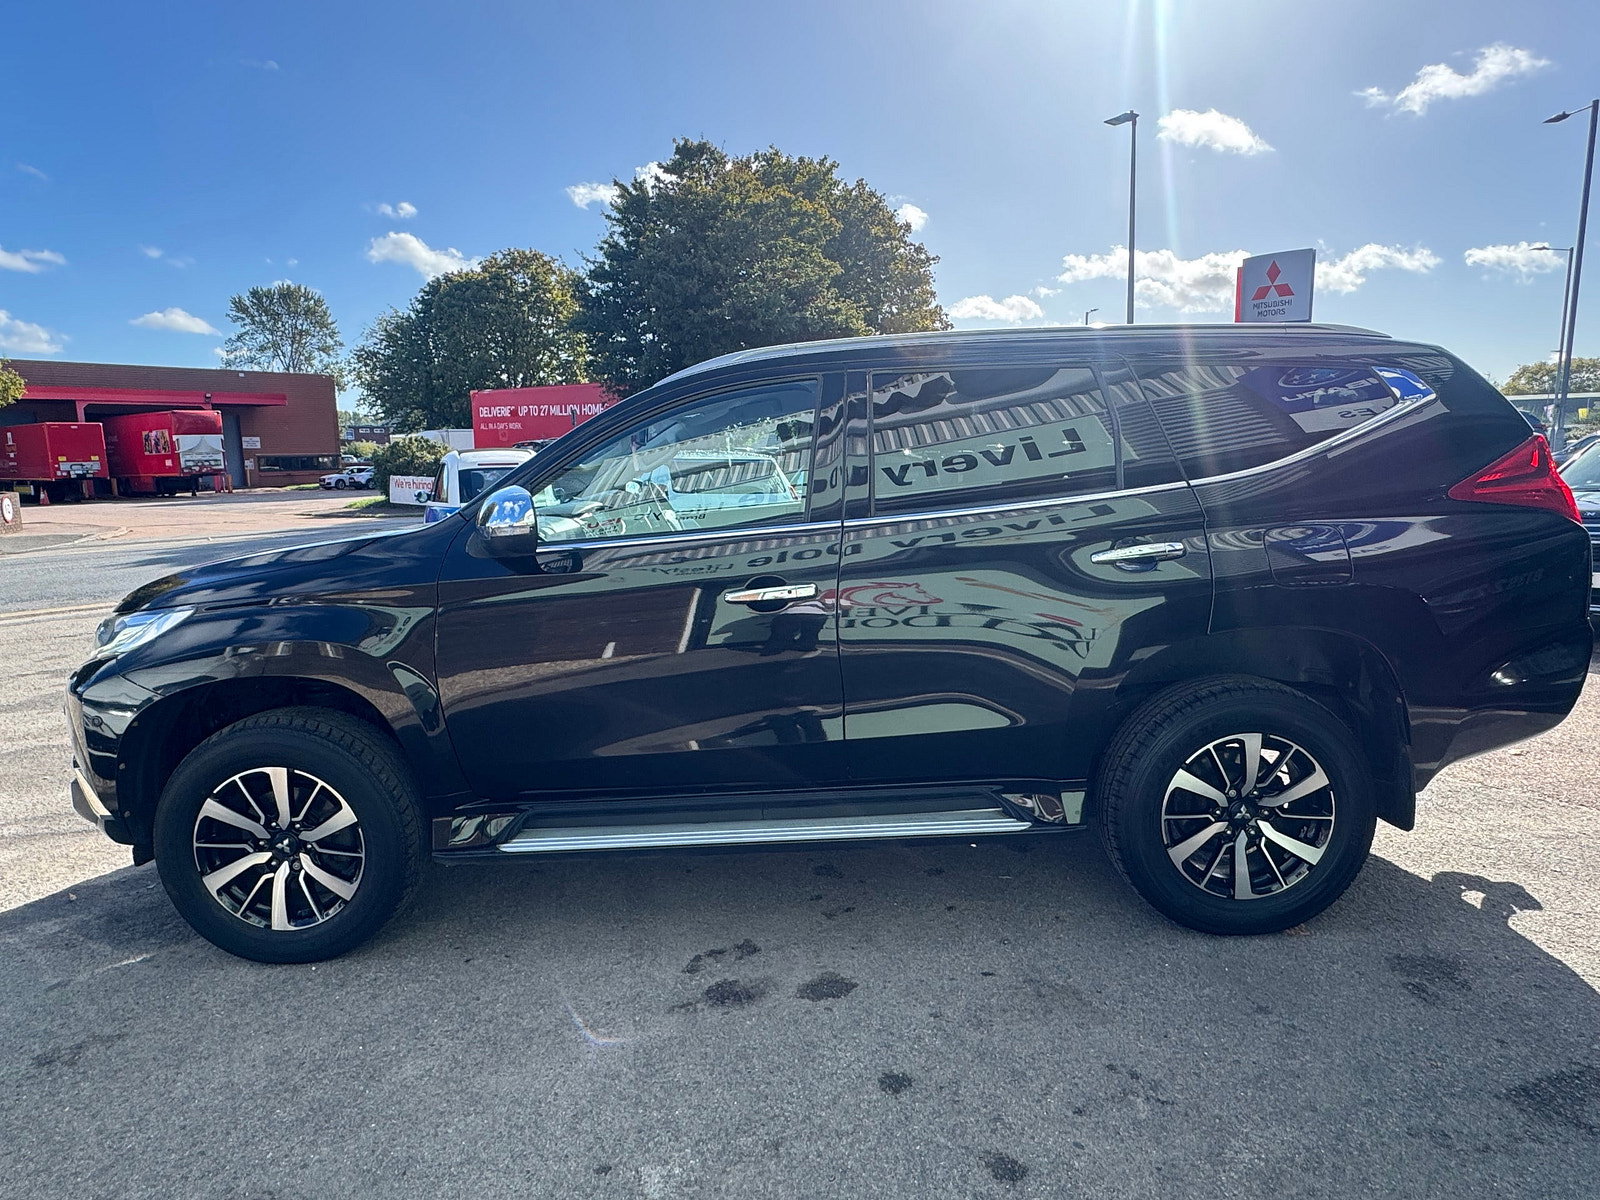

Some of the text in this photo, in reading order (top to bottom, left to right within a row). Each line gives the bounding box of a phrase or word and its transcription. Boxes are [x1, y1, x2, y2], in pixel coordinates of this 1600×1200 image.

[1252, 299, 1293, 310] MITSUBISHI
[1257, 308, 1286, 317] MOTORS
[518, 405, 529, 417] UP
[529, 405, 539, 417] TO
[540, 404, 549, 417] 27
